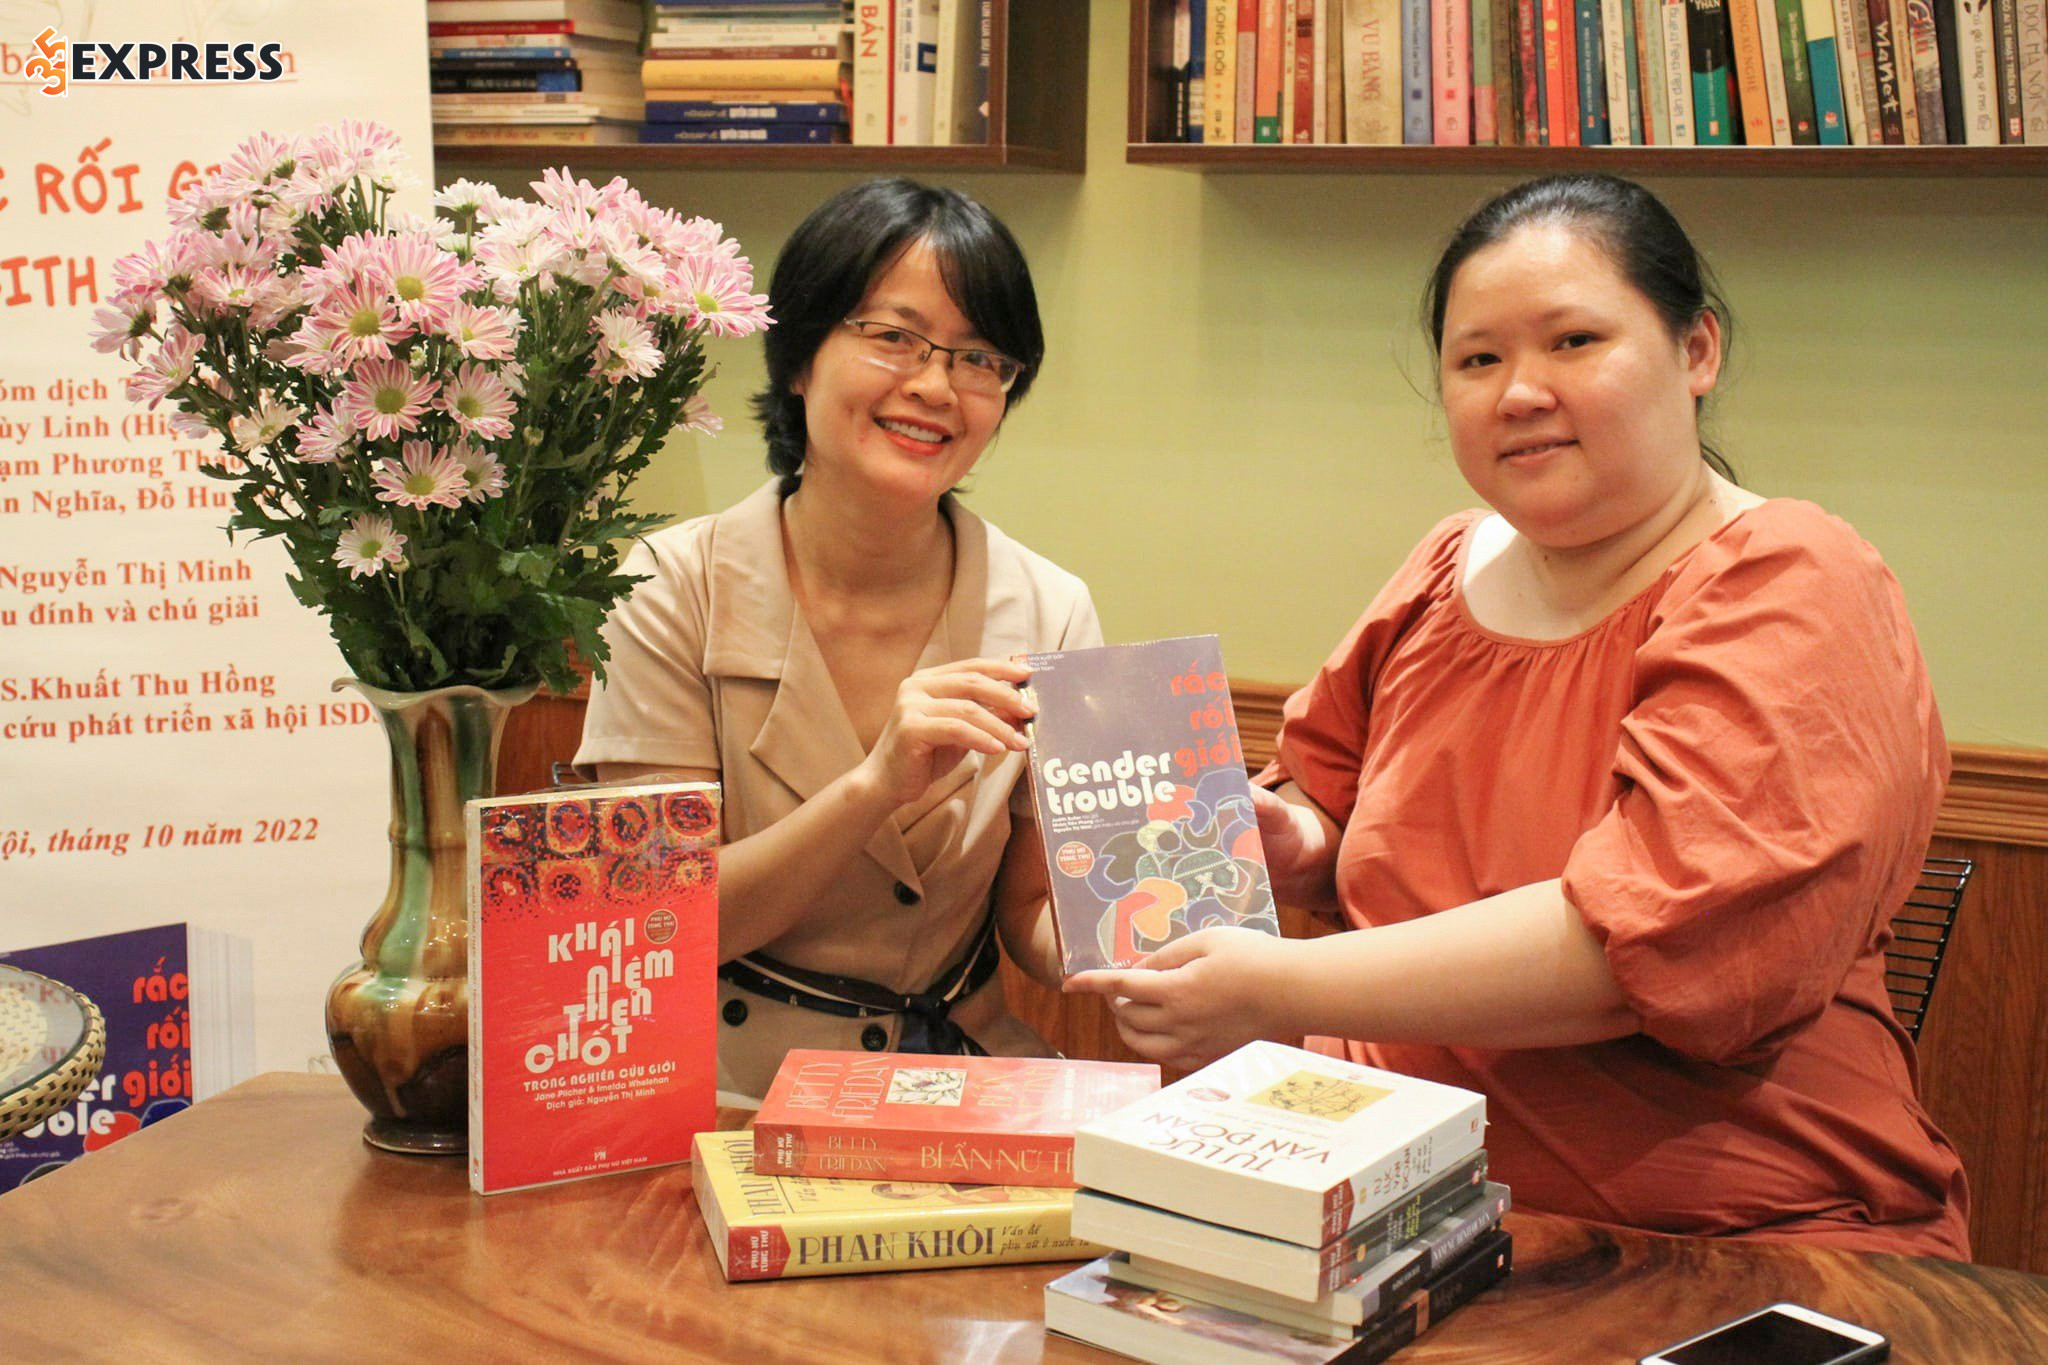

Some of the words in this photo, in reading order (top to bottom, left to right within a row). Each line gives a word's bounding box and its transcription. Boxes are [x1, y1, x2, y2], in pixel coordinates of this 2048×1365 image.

[34, 137, 143, 214] RỐI
[0, 256, 98, 307] ITH
[47, 377, 108, 407] dịch
[43, 414, 110, 438] Linh
[52, 450, 164, 479] Phương
[32, 489, 126, 518] Nghĩa,
[136, 481, 175, 510] Đỗ
[0, 558, 107, 594] Nguyễn
[118, 562, 166, 591] Thị
[178, 559, 251, 584] Minh
[29, 601, 93, 627] đính
[105, 600, 137, 623] và
[147, 597, 198, 621] chú
[208, 596, 260, 627] giải
[131, 672, 188, 697] Thu
[200, 664, 276, 698] Hồng
[3, 714, 57, 740] cứu
[68, 712, 133, 743] phát
[145, 702, 211, 734] triển
[223, 709, 254, 731] xã
[265, 705, 308, 735] hội
[319, 701, 381, 727] ISD
[1190, 695, 1237, 730] rối
[1043, 750, 1171, 788] Gender
[1174, 730, 1245, 777] giới
[1046, 777, 1177, 816] trouble
[0, 831, 36, 861] ội,
[47, 828, 130, 857] tháng
[142, 824, 174, 848] 10
[182, 823, 243, 847] năm
[253, 817, 319, 843] 2022
[548, 918, 635, 964] KHÁI
[146, 1006, 190, 1050] rối
[524, 1024, 633, 1074] CHỐT
[122, 1053, 192, 1108] giới
[523, 1077, 567, 1092] TRONG
[570, 1070, 615, 1086] NGHIÊN
[619, 1063, 645, 1078] CỨU
[649, 1061, 676, 1075] GIỚI
[920, 1142, 944, 1169] BÍ
[999, 1149, 1043, 1173] NỮ
[1047, 1148, 1075, 1174] TÍ
[798, 1231, 898, 1266] PHAN
[907, 1224, 997, 1259] KHÔI
